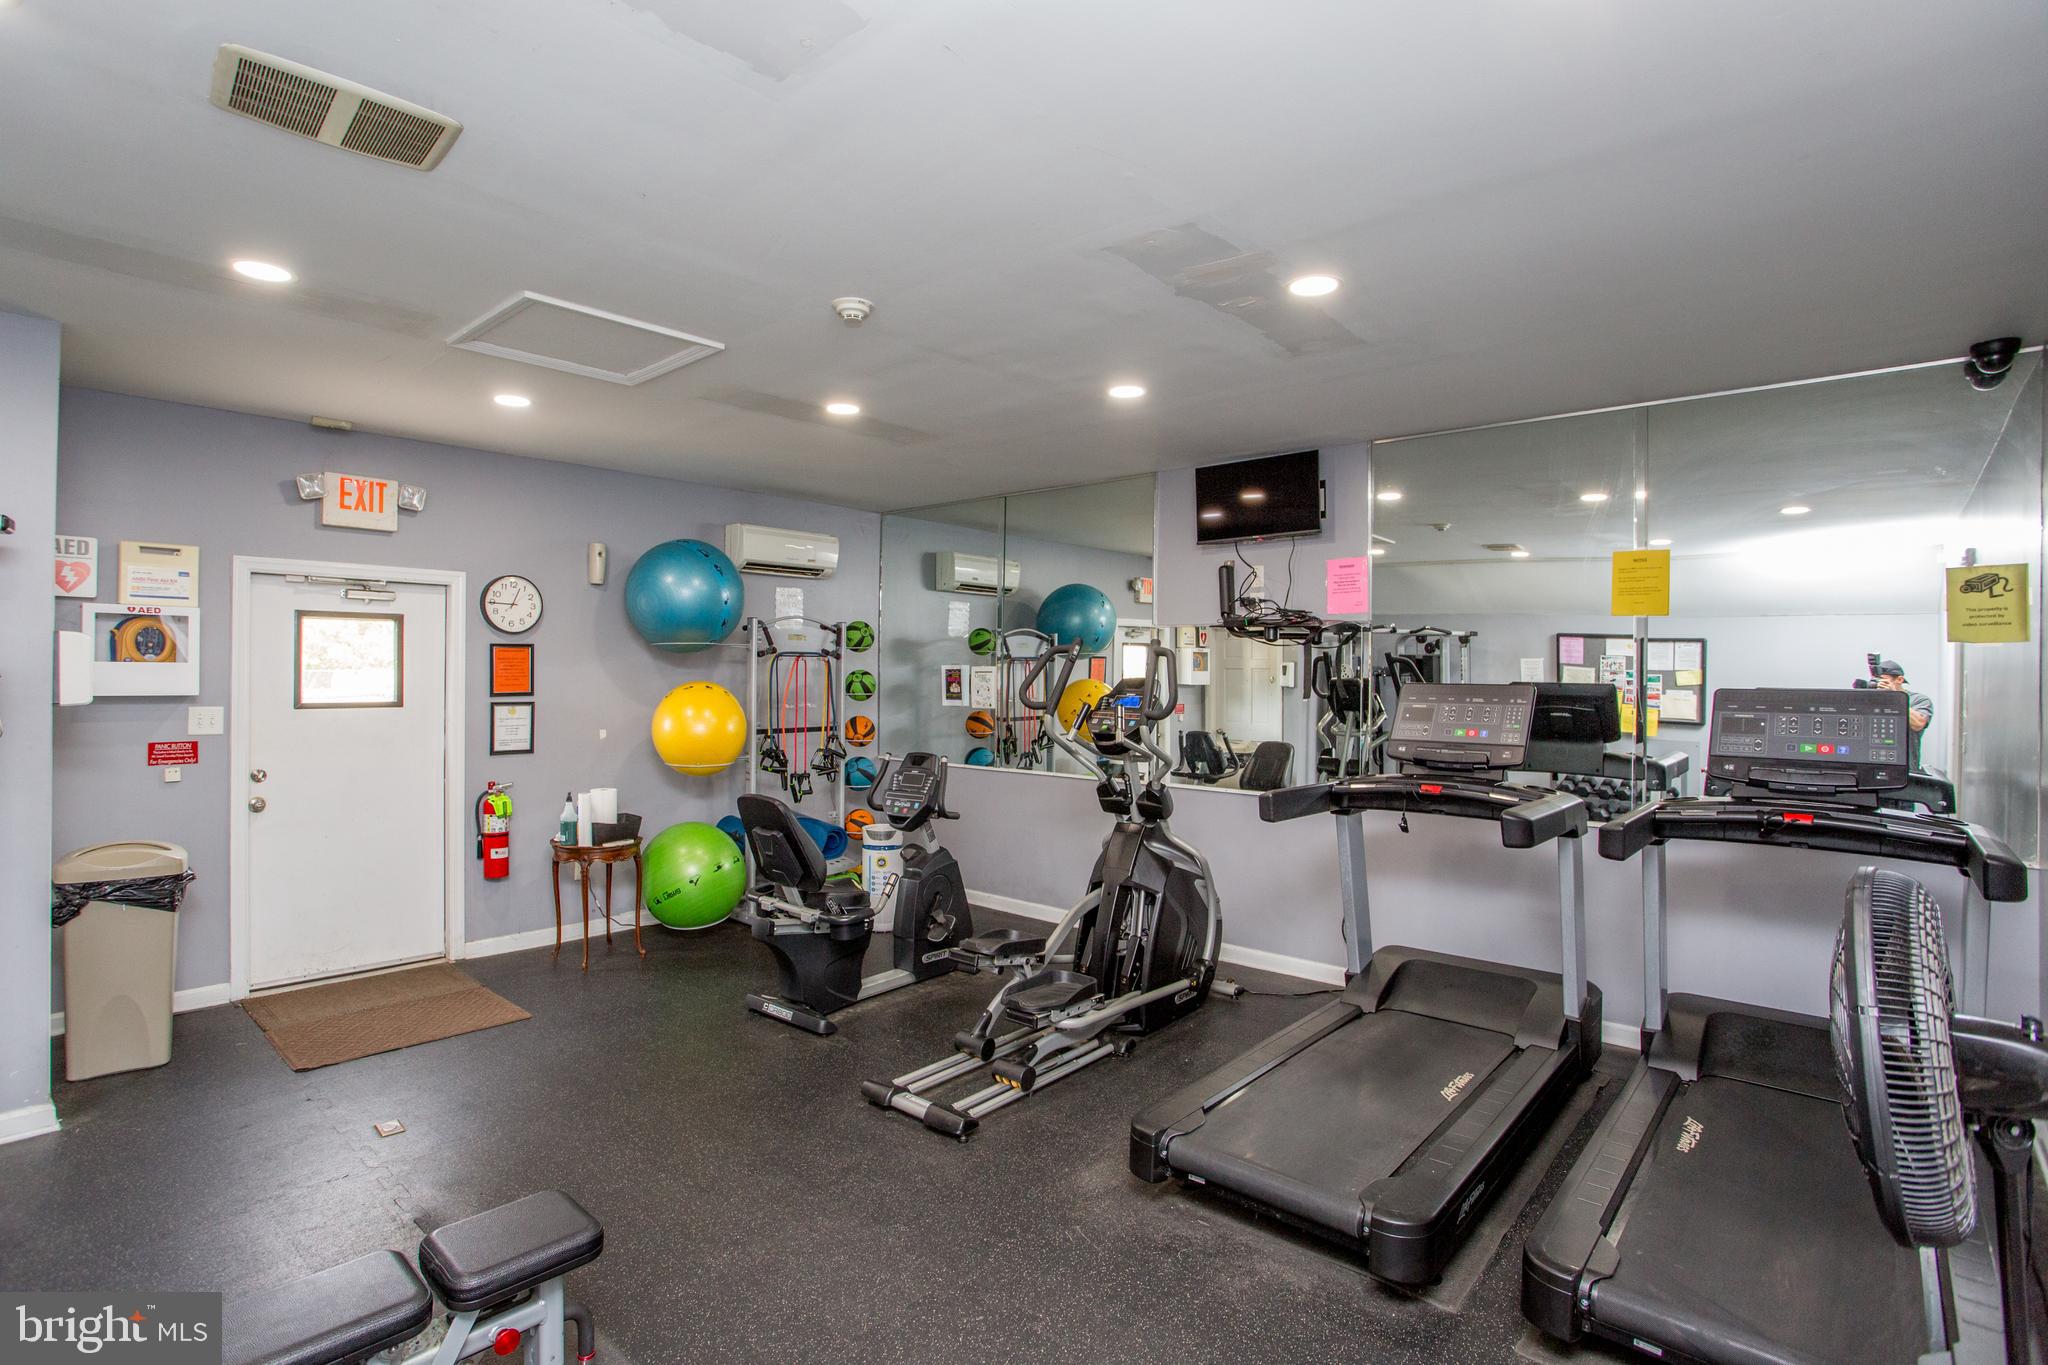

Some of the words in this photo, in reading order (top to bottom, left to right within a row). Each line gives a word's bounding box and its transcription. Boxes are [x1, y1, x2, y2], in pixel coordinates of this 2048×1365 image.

[340, 477, 387, 513] EXIT
[492, 590, 501, 598] 10
[530, 602, 536, 610] 3
